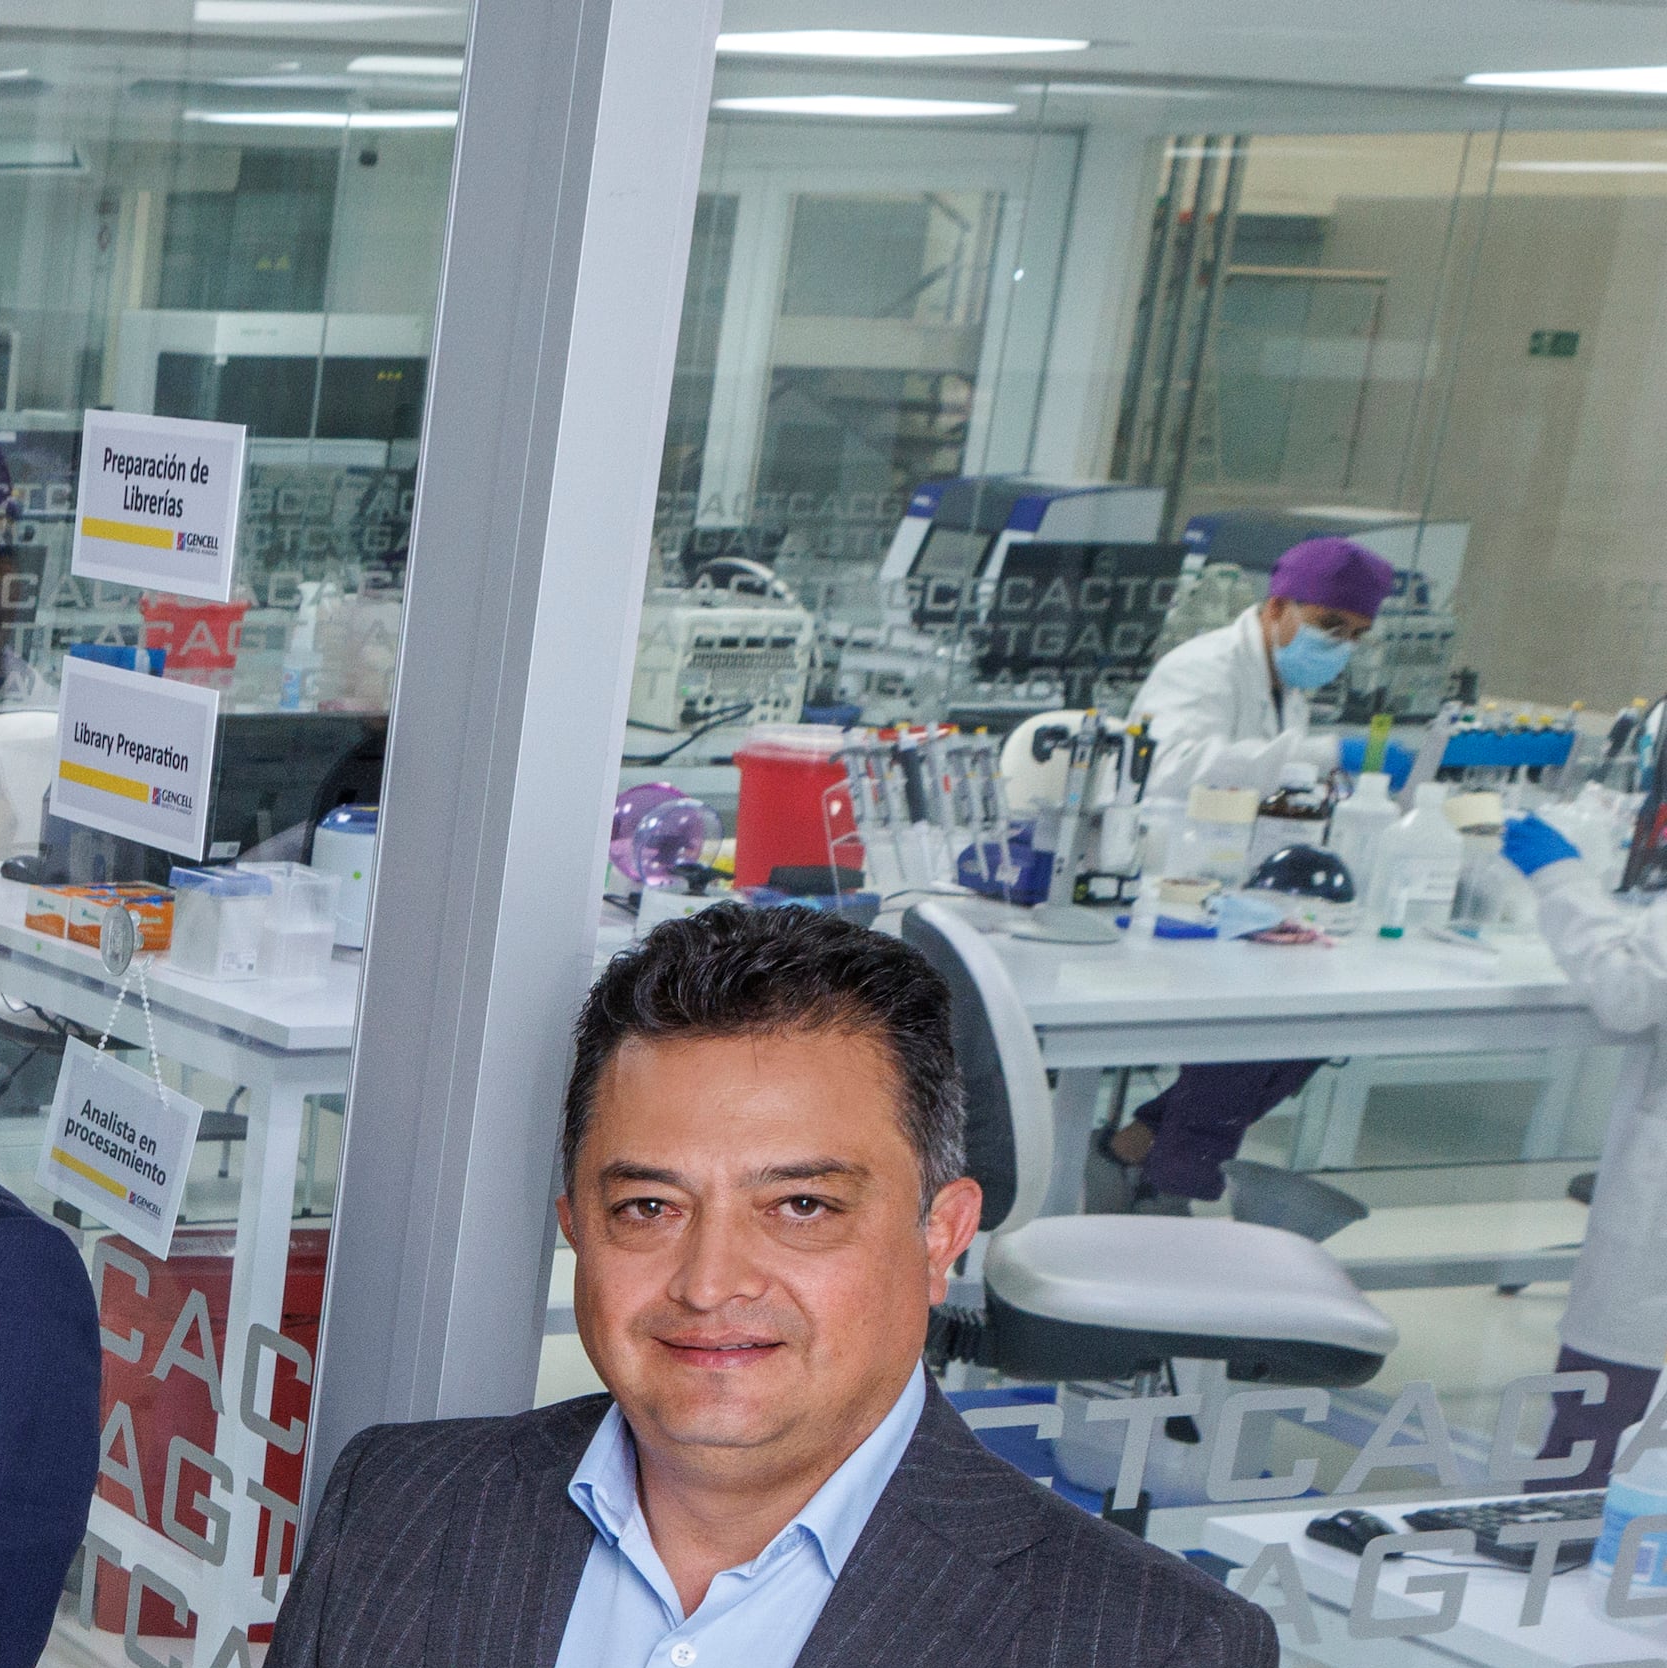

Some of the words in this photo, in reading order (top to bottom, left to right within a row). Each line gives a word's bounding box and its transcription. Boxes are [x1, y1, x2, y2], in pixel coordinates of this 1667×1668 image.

[103, 447, 186, 481] Preparación
[190, 456, 209, 484] de
[123, 485, 183, 518] Librerías
[186, 532, 219, 550] GENCELL
[74, 721, 114, 756] Library
[117, 733, 189, 772] Preparation
[161, 789, 193, 809] GENCELL
[64, 1117, 166, 1186] procesamiento
[80, 1099, 136, 1145] Analista
[139, 1134, 157, 1156] en
[92, 1241, 312, 1455] CAC
[98, 1400, 297, 1604] AGT
